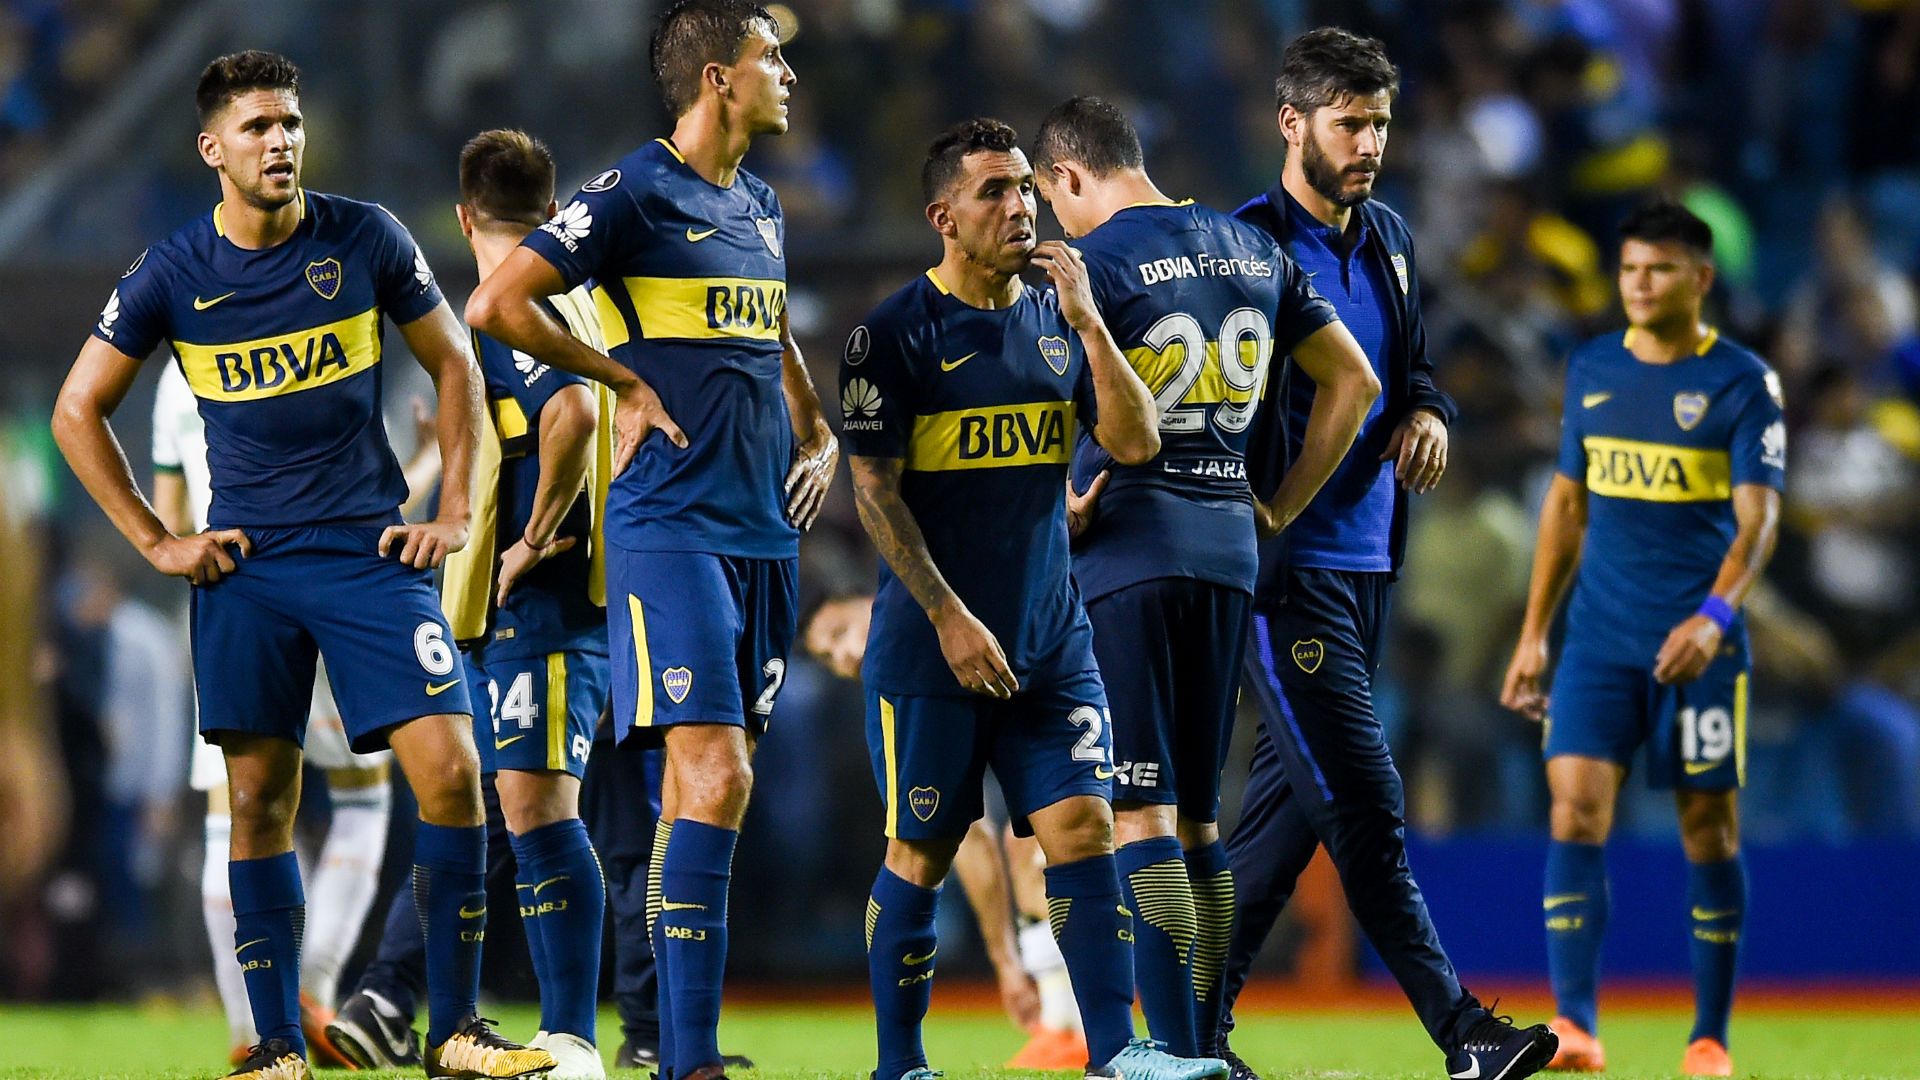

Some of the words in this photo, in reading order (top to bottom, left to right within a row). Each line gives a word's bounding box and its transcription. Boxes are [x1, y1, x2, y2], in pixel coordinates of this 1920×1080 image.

[1139, 256, 1198, 286] BBVA
[1198, 253, 1272, 278] Francés
[215, 332, 349, 393] BBVA
[1142, 307, 1271, 433] 29
[959, 410, 1065, 460] BBVA
[1164, 461, 1180, 473] L.
[1191, 461, 1247, 480] JARA
[1588, 448, 1689, 492] BBVA
[414, 621, 454, 676] 6
[751, 657, 785, 715] 2
[1681, 706, 1733, 761] 19
[913, 797, 934, 805] CABJ
[664, 925, 706, 941] CABJ
